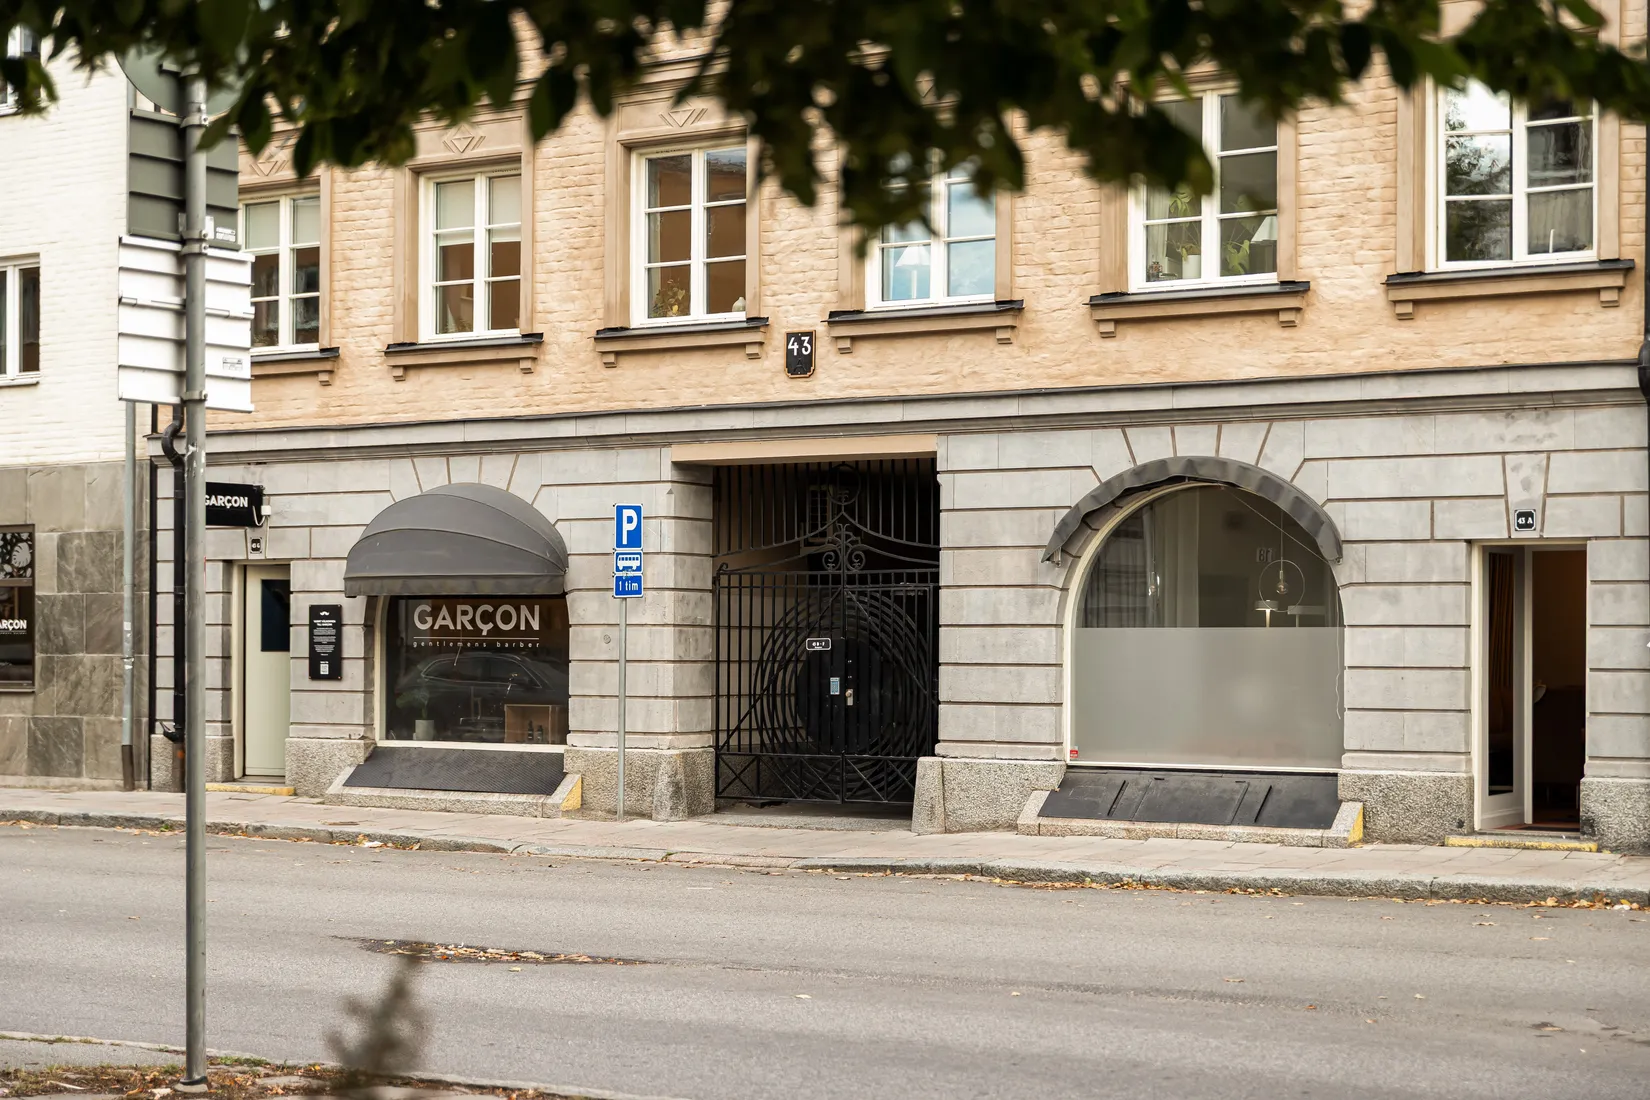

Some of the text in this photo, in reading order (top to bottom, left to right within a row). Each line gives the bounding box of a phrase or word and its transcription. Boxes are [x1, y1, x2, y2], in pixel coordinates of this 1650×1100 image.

[787, 336, 812, 356] 43
[622, 508, 638, 545] P
[618, 580, 639, 591] 1 tim
[413, 604, 540, 636] GARÇON
